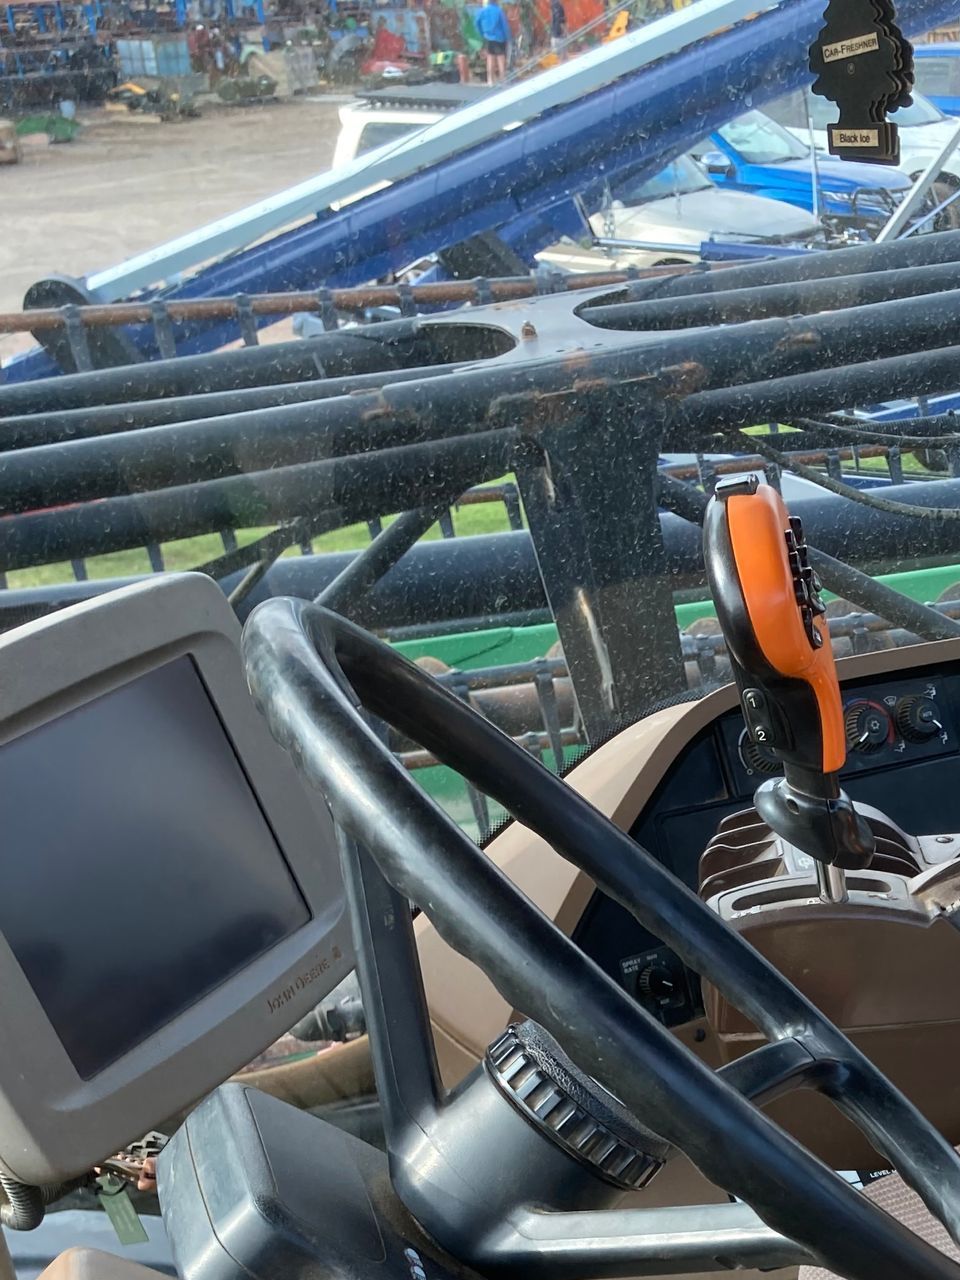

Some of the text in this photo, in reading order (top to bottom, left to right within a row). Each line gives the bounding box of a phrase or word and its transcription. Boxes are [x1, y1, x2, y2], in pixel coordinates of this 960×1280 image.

[823, 38, 878, 59] CAR-FRESHNER
[839, 133, 871, 144] Black Ice
[749, 697, 756, 708] 1
[757, 730, 767, 741] 2
[621, 957, 641, 968] SPRAY
[623, 964, 640, 975] RATE
[266, 984, 297, 1014] JOHN
